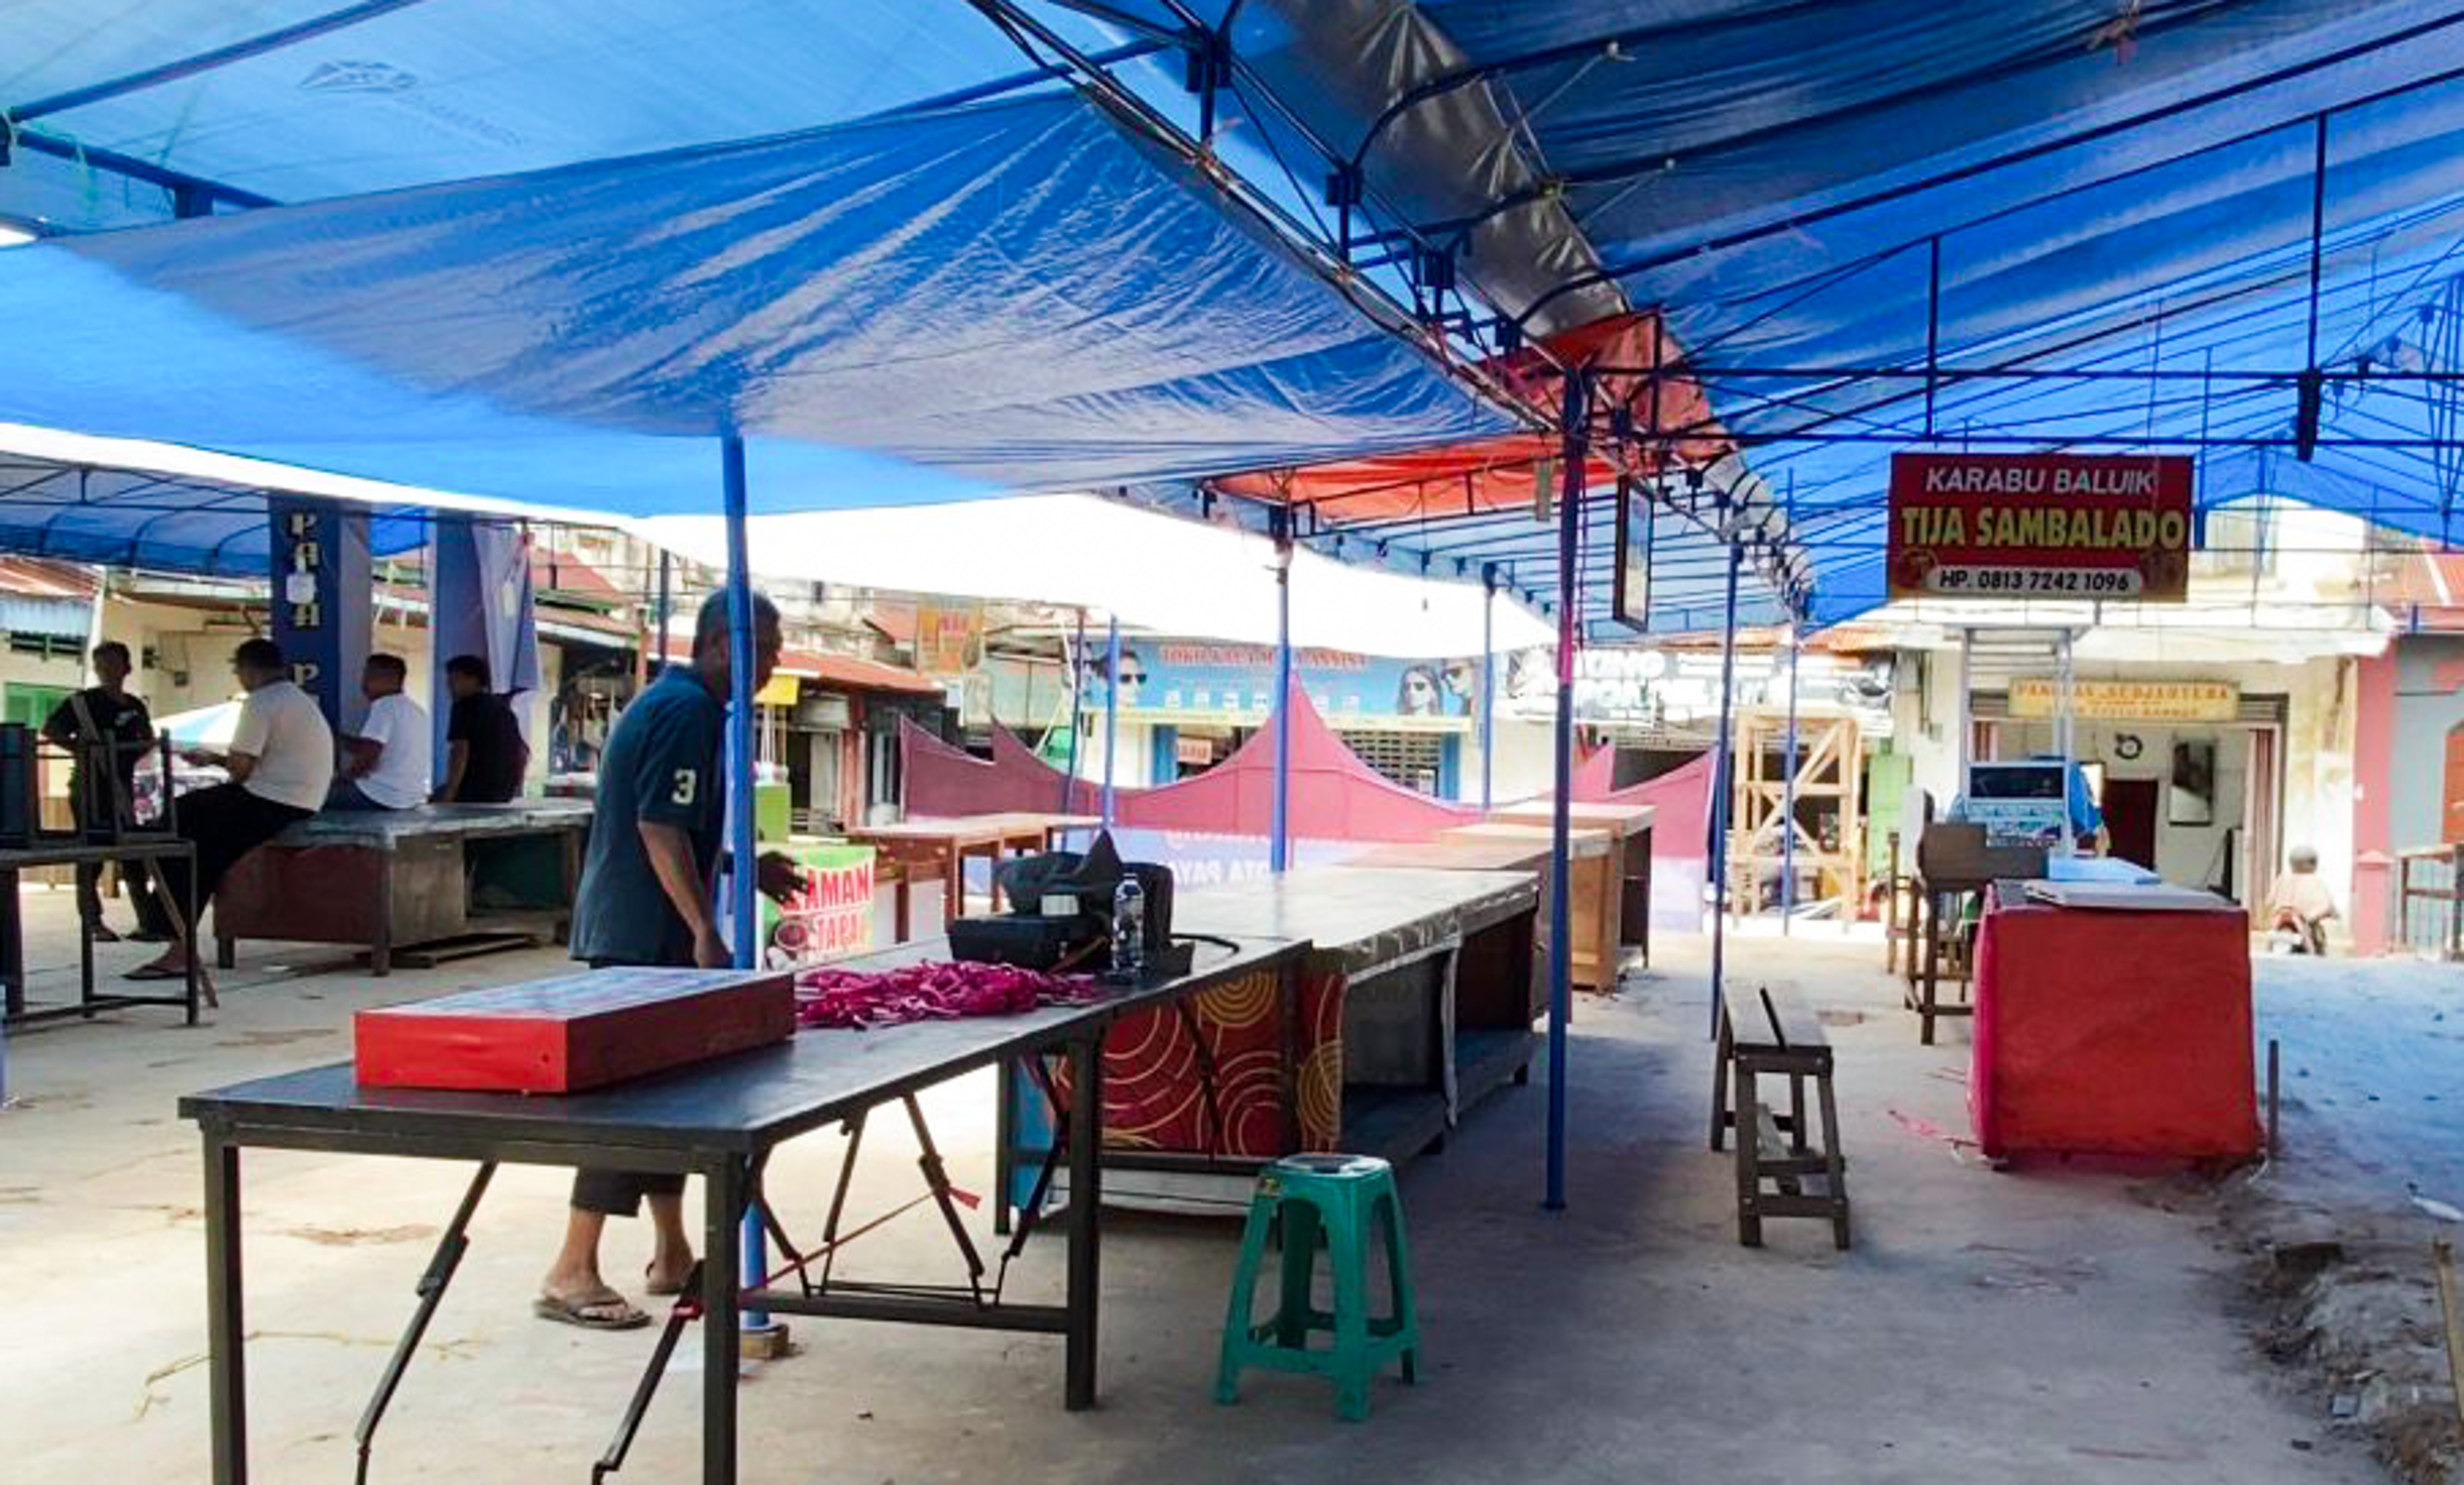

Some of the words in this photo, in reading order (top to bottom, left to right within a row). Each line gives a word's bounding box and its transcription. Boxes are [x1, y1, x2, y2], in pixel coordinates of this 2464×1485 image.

[1926, 467, 2046, 492] KARABU
[2053, 468, 2154, 495] BALUIK
[1901, 507, 1966, 545] TIJA
[1976, 507, 2185, 550] SAMBALADO
[1940, 569, 1971, 588] HP.
[1978, 571, 2022, 589] 0813
[2031, 571, 2077, 590] 7242
[2085, 572, 2129, 591] 1096
[671, 768, 697, 805] 3
